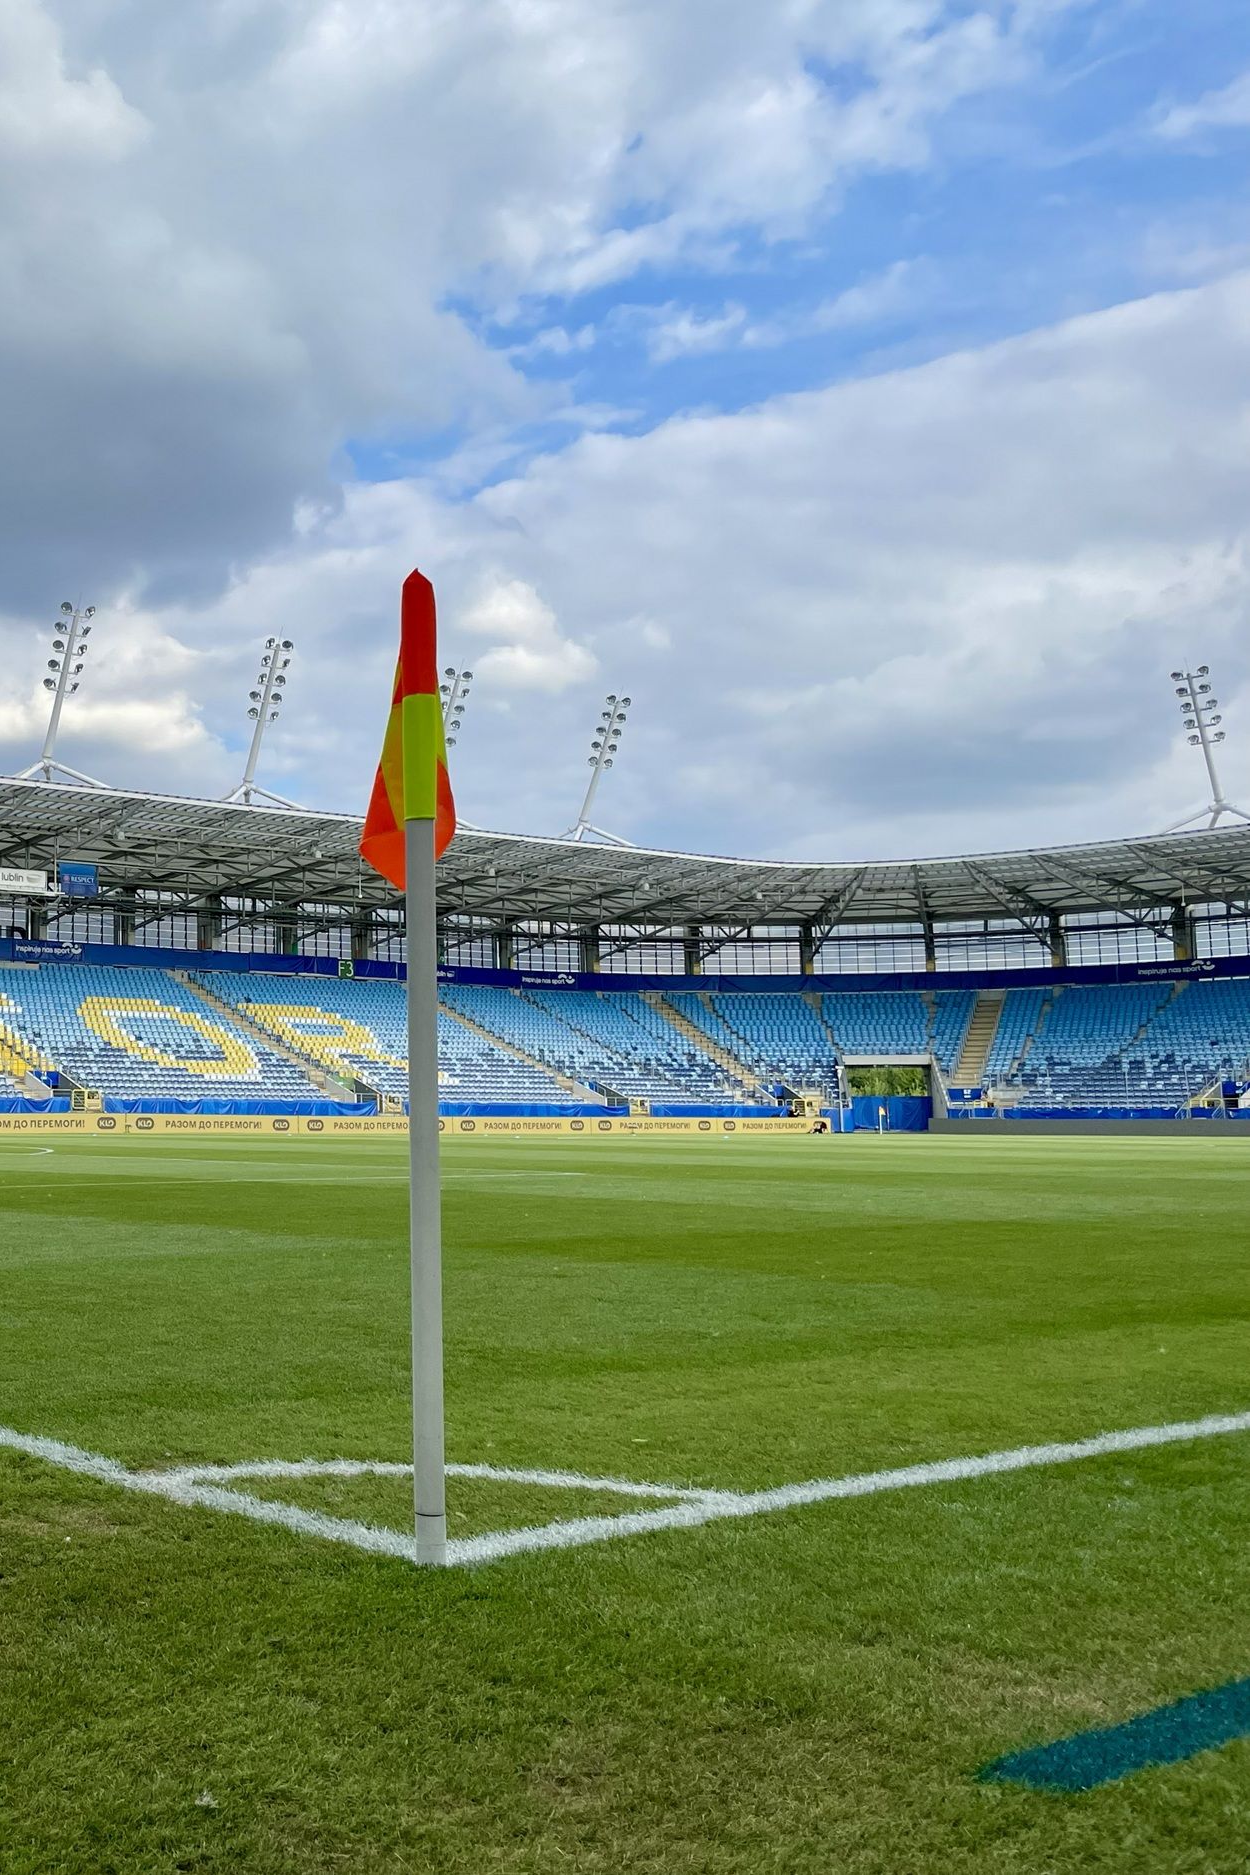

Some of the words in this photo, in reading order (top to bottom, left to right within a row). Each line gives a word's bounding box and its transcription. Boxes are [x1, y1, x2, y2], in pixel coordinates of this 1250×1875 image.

[1, 872, 24, 883] lublin
[337, 960, 354, 977] F3
[13, 1119, 28, 1130] ДО
[30, 1118, 86, 1129] ПЕРЕМОГИ!
[165, 1120, 197, 1129] РАЗОМ
[199, 1120, 211, 1130] ДО
[213, 1121, 262, 1130] ПЕРЕМОГИ!
[333, 1121, 362, 1130] РАЗОМ
[363, 1121, 375, 1131] ДО
[376, 1121, 408, 1130] ПЕРЕМО
[484, 1122, 510, 1130] РАЗОМ
[511, 1122, 522, 1131] ДО
